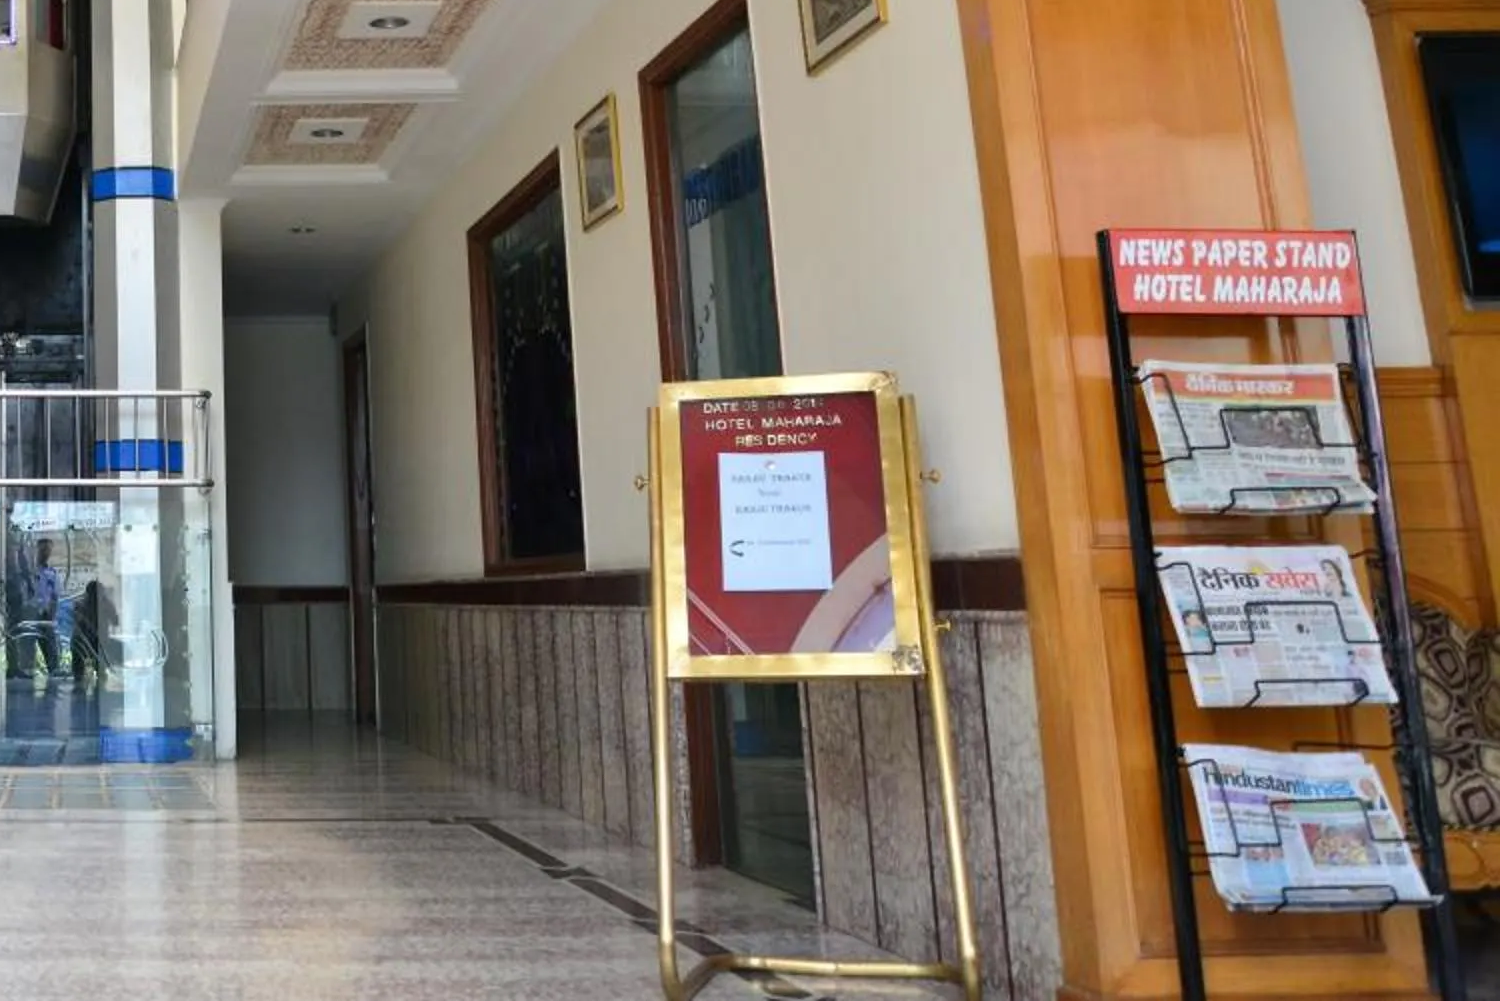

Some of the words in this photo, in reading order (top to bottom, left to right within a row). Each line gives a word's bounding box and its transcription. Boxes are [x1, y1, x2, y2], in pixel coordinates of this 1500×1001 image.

[1119, 238, 1185, 267] NEWS
[1192, 239, 1268, 269] PAPER
[1275, 240, 1350, 269] STAND
[1134, 274, 1206, 302] HOTEL
[1214, 275, 1342, 304] MAHARAJA
[703, 401, 739, 414] DATE
[705, 418, 754, 431] HOTEL
[761, 414, 842, 428] MAHARAJA
[735, 432, 818, 447] RESDENCY
[1199, 567, 1260, 590] दैनिक
